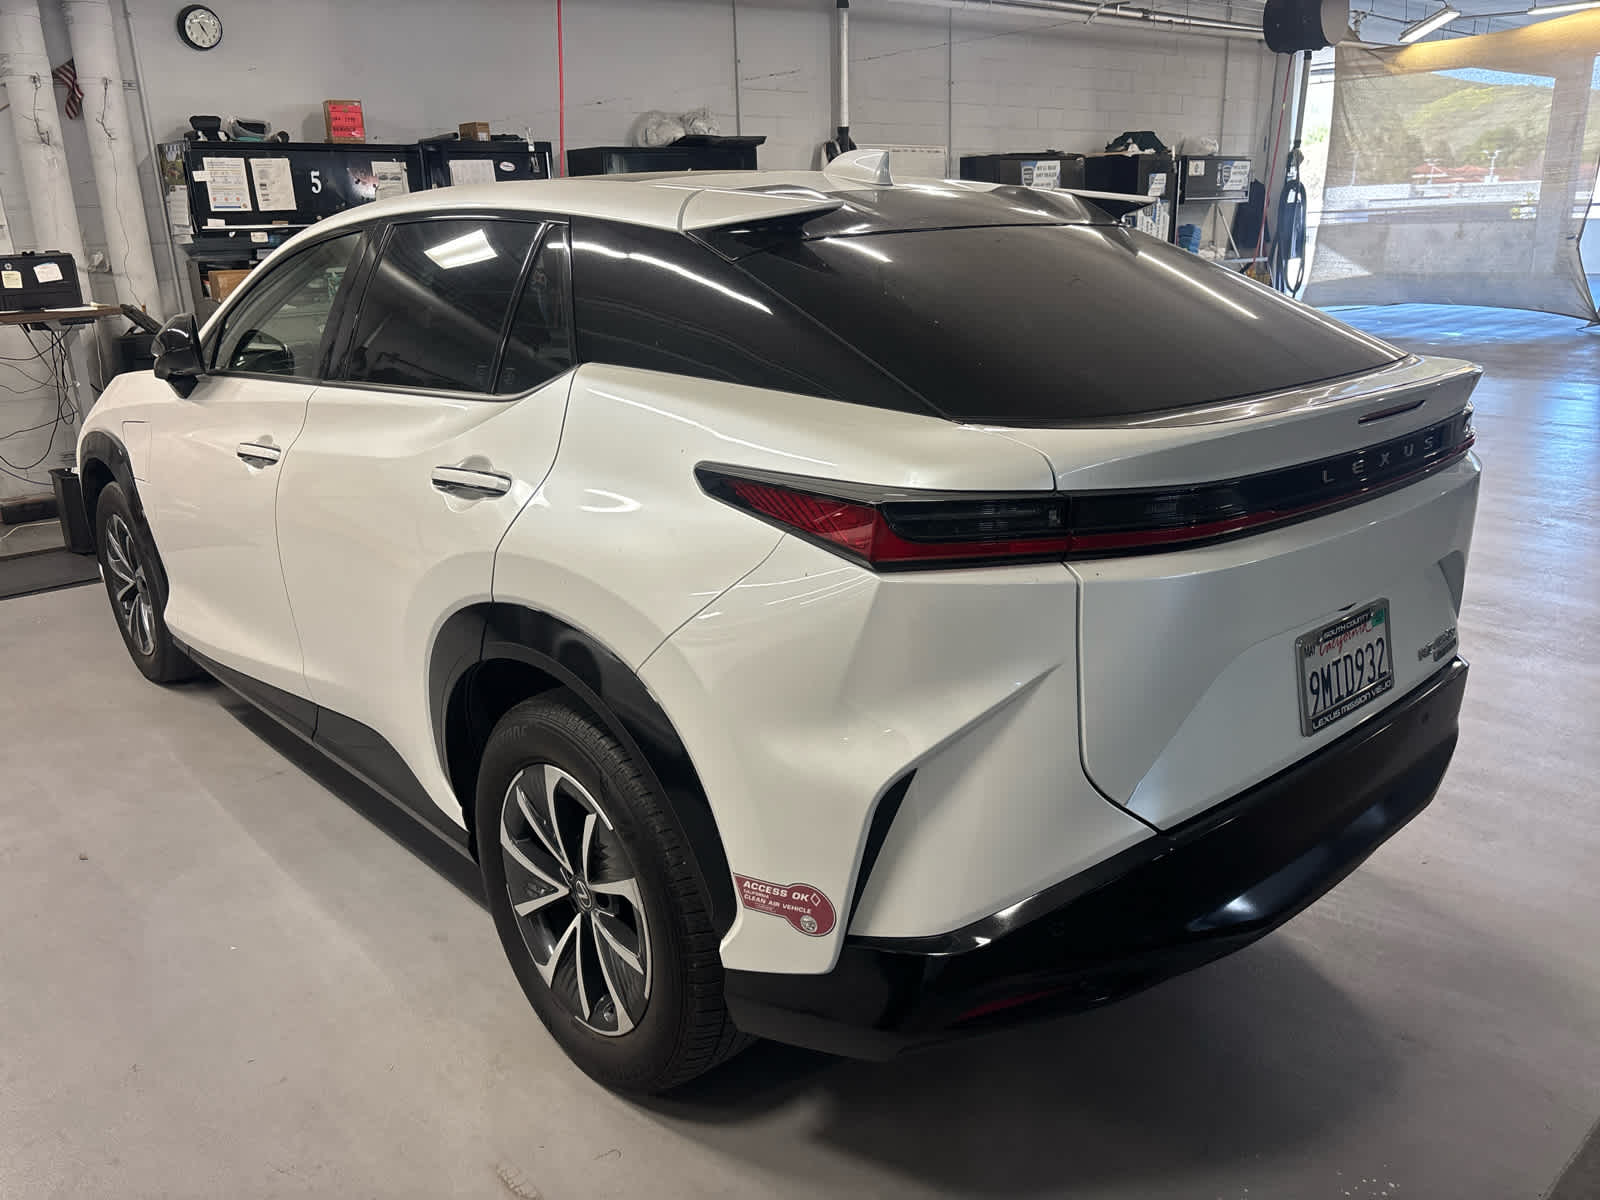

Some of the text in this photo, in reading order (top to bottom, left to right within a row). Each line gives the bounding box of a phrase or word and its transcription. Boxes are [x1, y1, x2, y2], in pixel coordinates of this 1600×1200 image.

[310, 170, 322, 194] 5
[1321, 436, 1434, 485] LEXUS
[1304, 643, 1316, 657] MAY
[1309, 637, 1386, 717] 9MID932
[1313, 709, 1341, 730] LEXUS
[743, 880, 811, 902] ACCESS OK
[743, 893, 766, 904] CLEAN
[768, 899, 780, 907] AIR
[782, 902, 812, 914] VEHICLE
